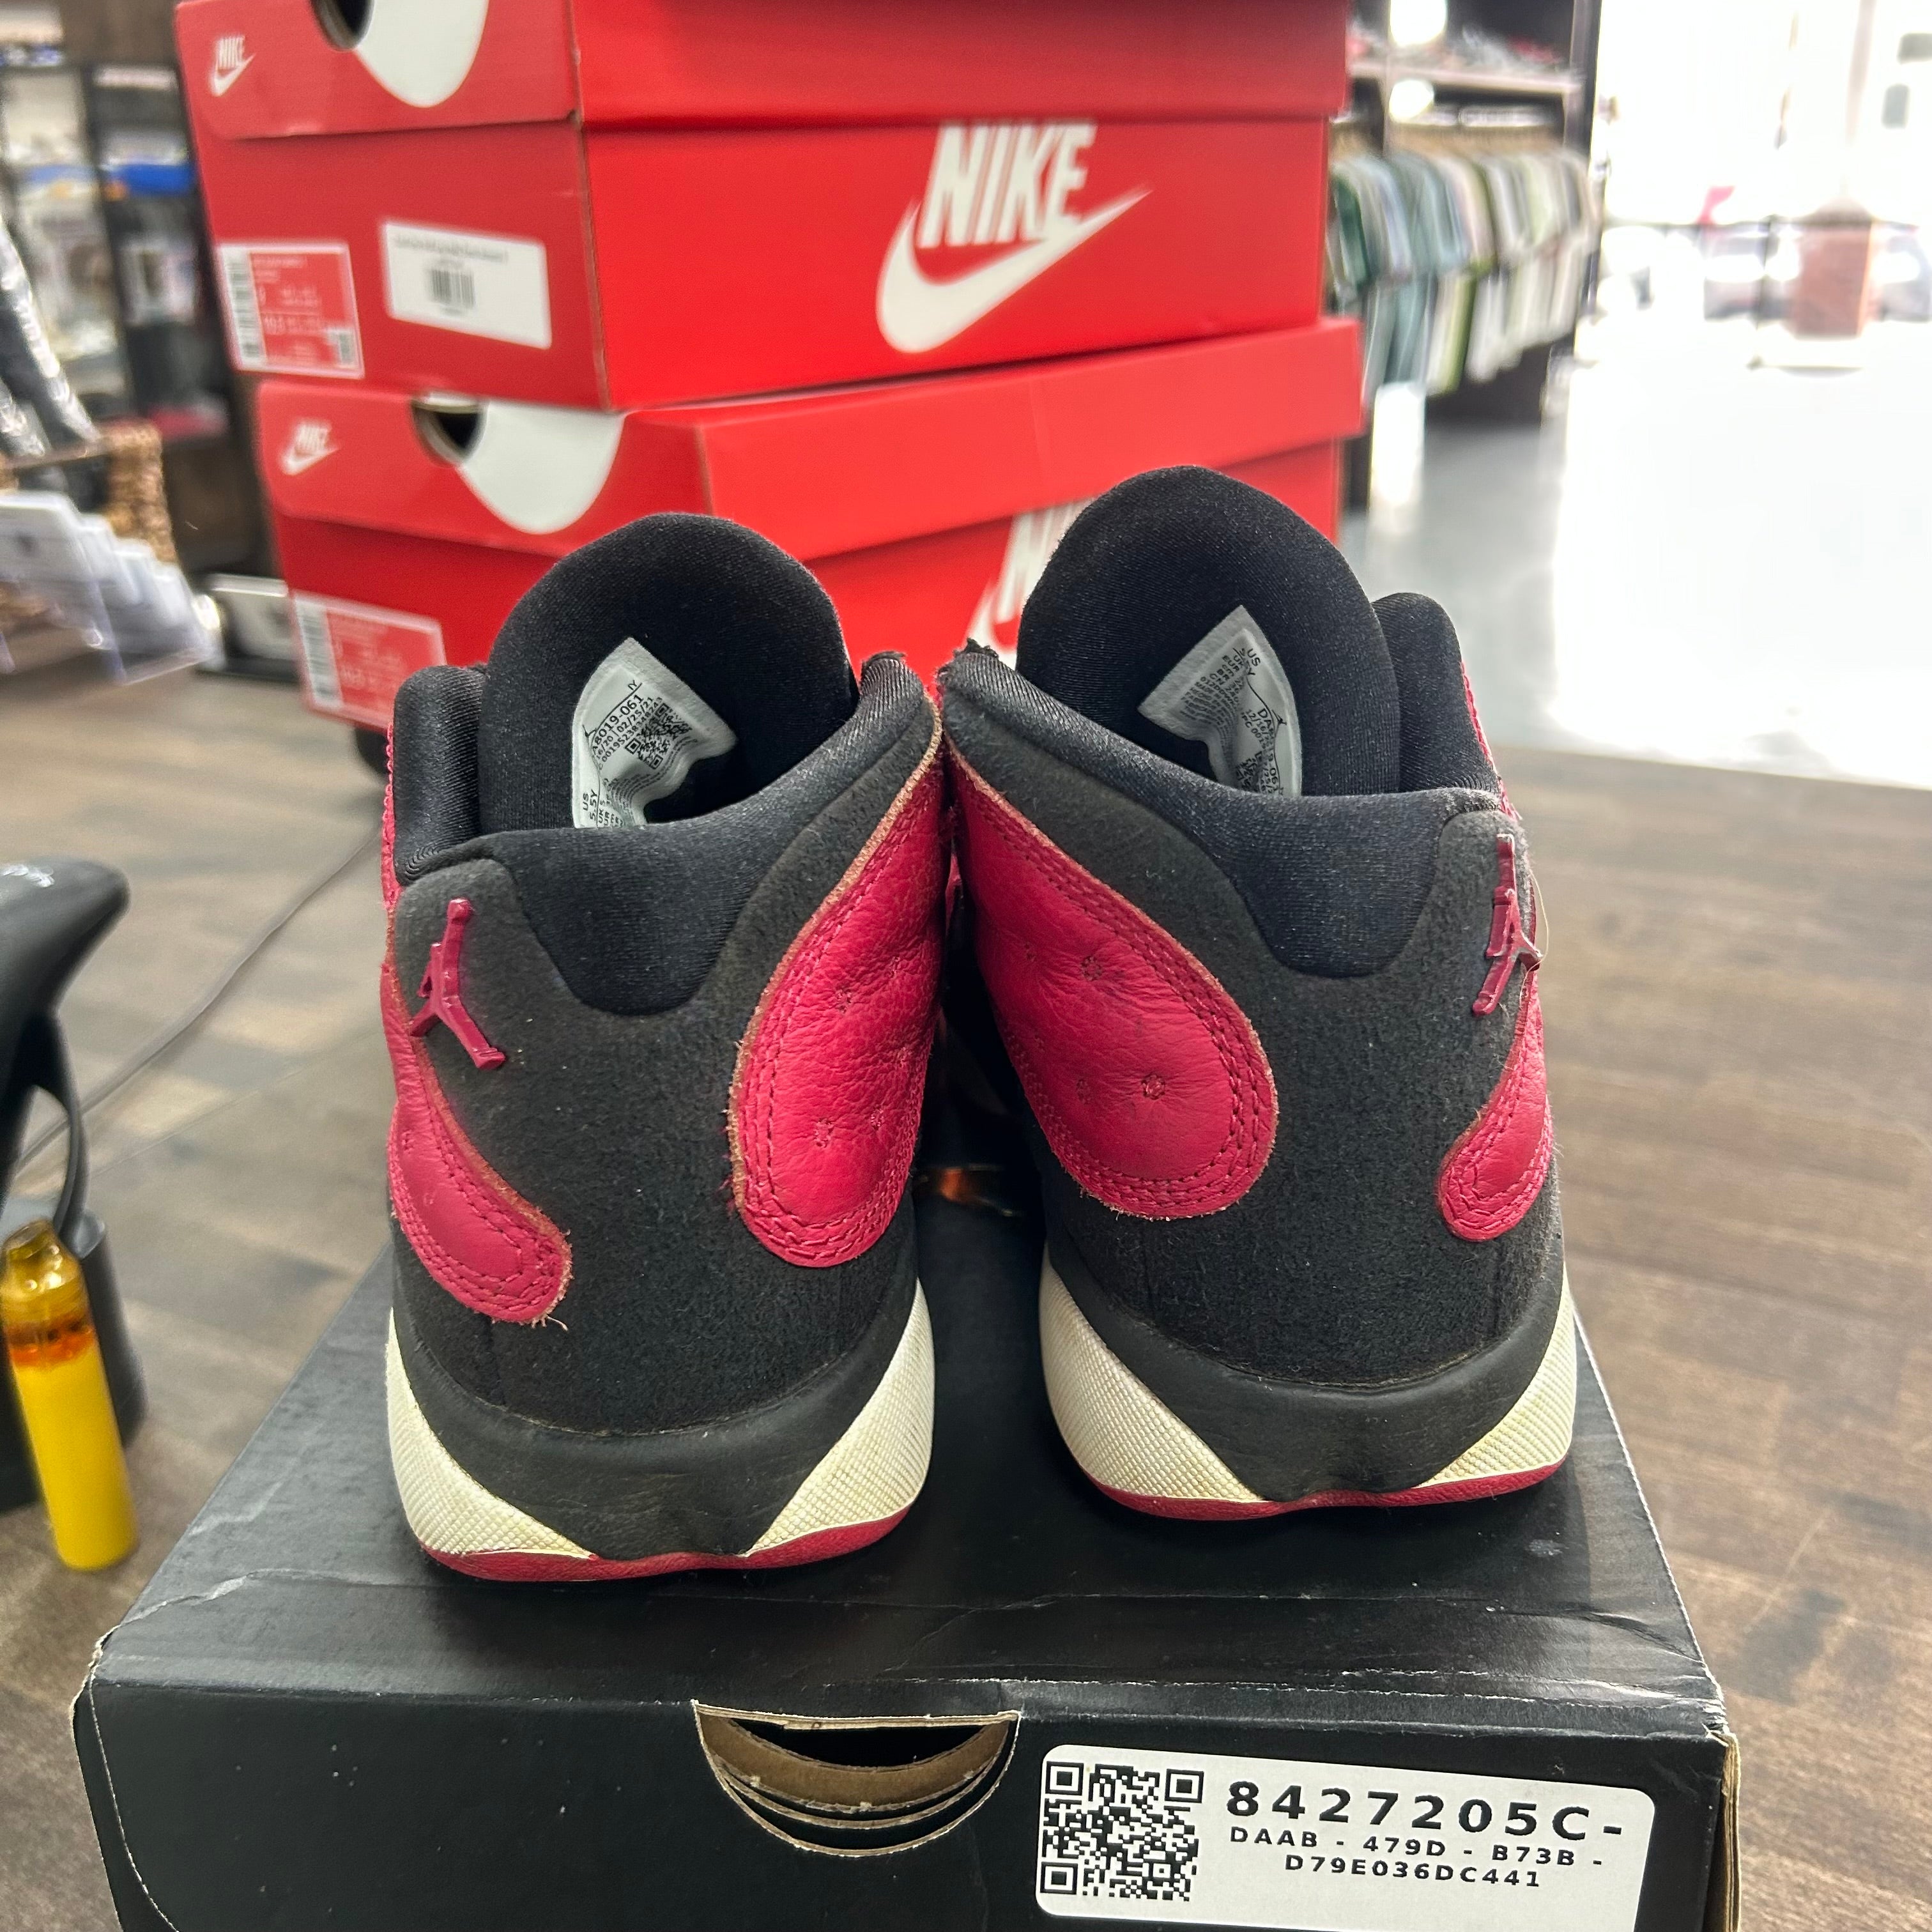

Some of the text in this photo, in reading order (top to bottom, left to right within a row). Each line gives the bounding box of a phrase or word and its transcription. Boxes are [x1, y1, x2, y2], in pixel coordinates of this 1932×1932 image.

[217, 36, 245, 68] NIKE
[916, 121, 1098, 249] NIKE
[1222, 656, 1239, 672] EUR
[1247, 648, 1261, 667] US
[583, 793, 589, 812] US
[1227, 1781, 1621, 1841] 8427205C-
[1230, 1827, 1317, 1847] DAAB
[1363, 1837, 1445, 1856] 479D
[1492, 1845, 1574, 1865] B73B
[1286, 1855, 1538, 1887] D79E036DC441
